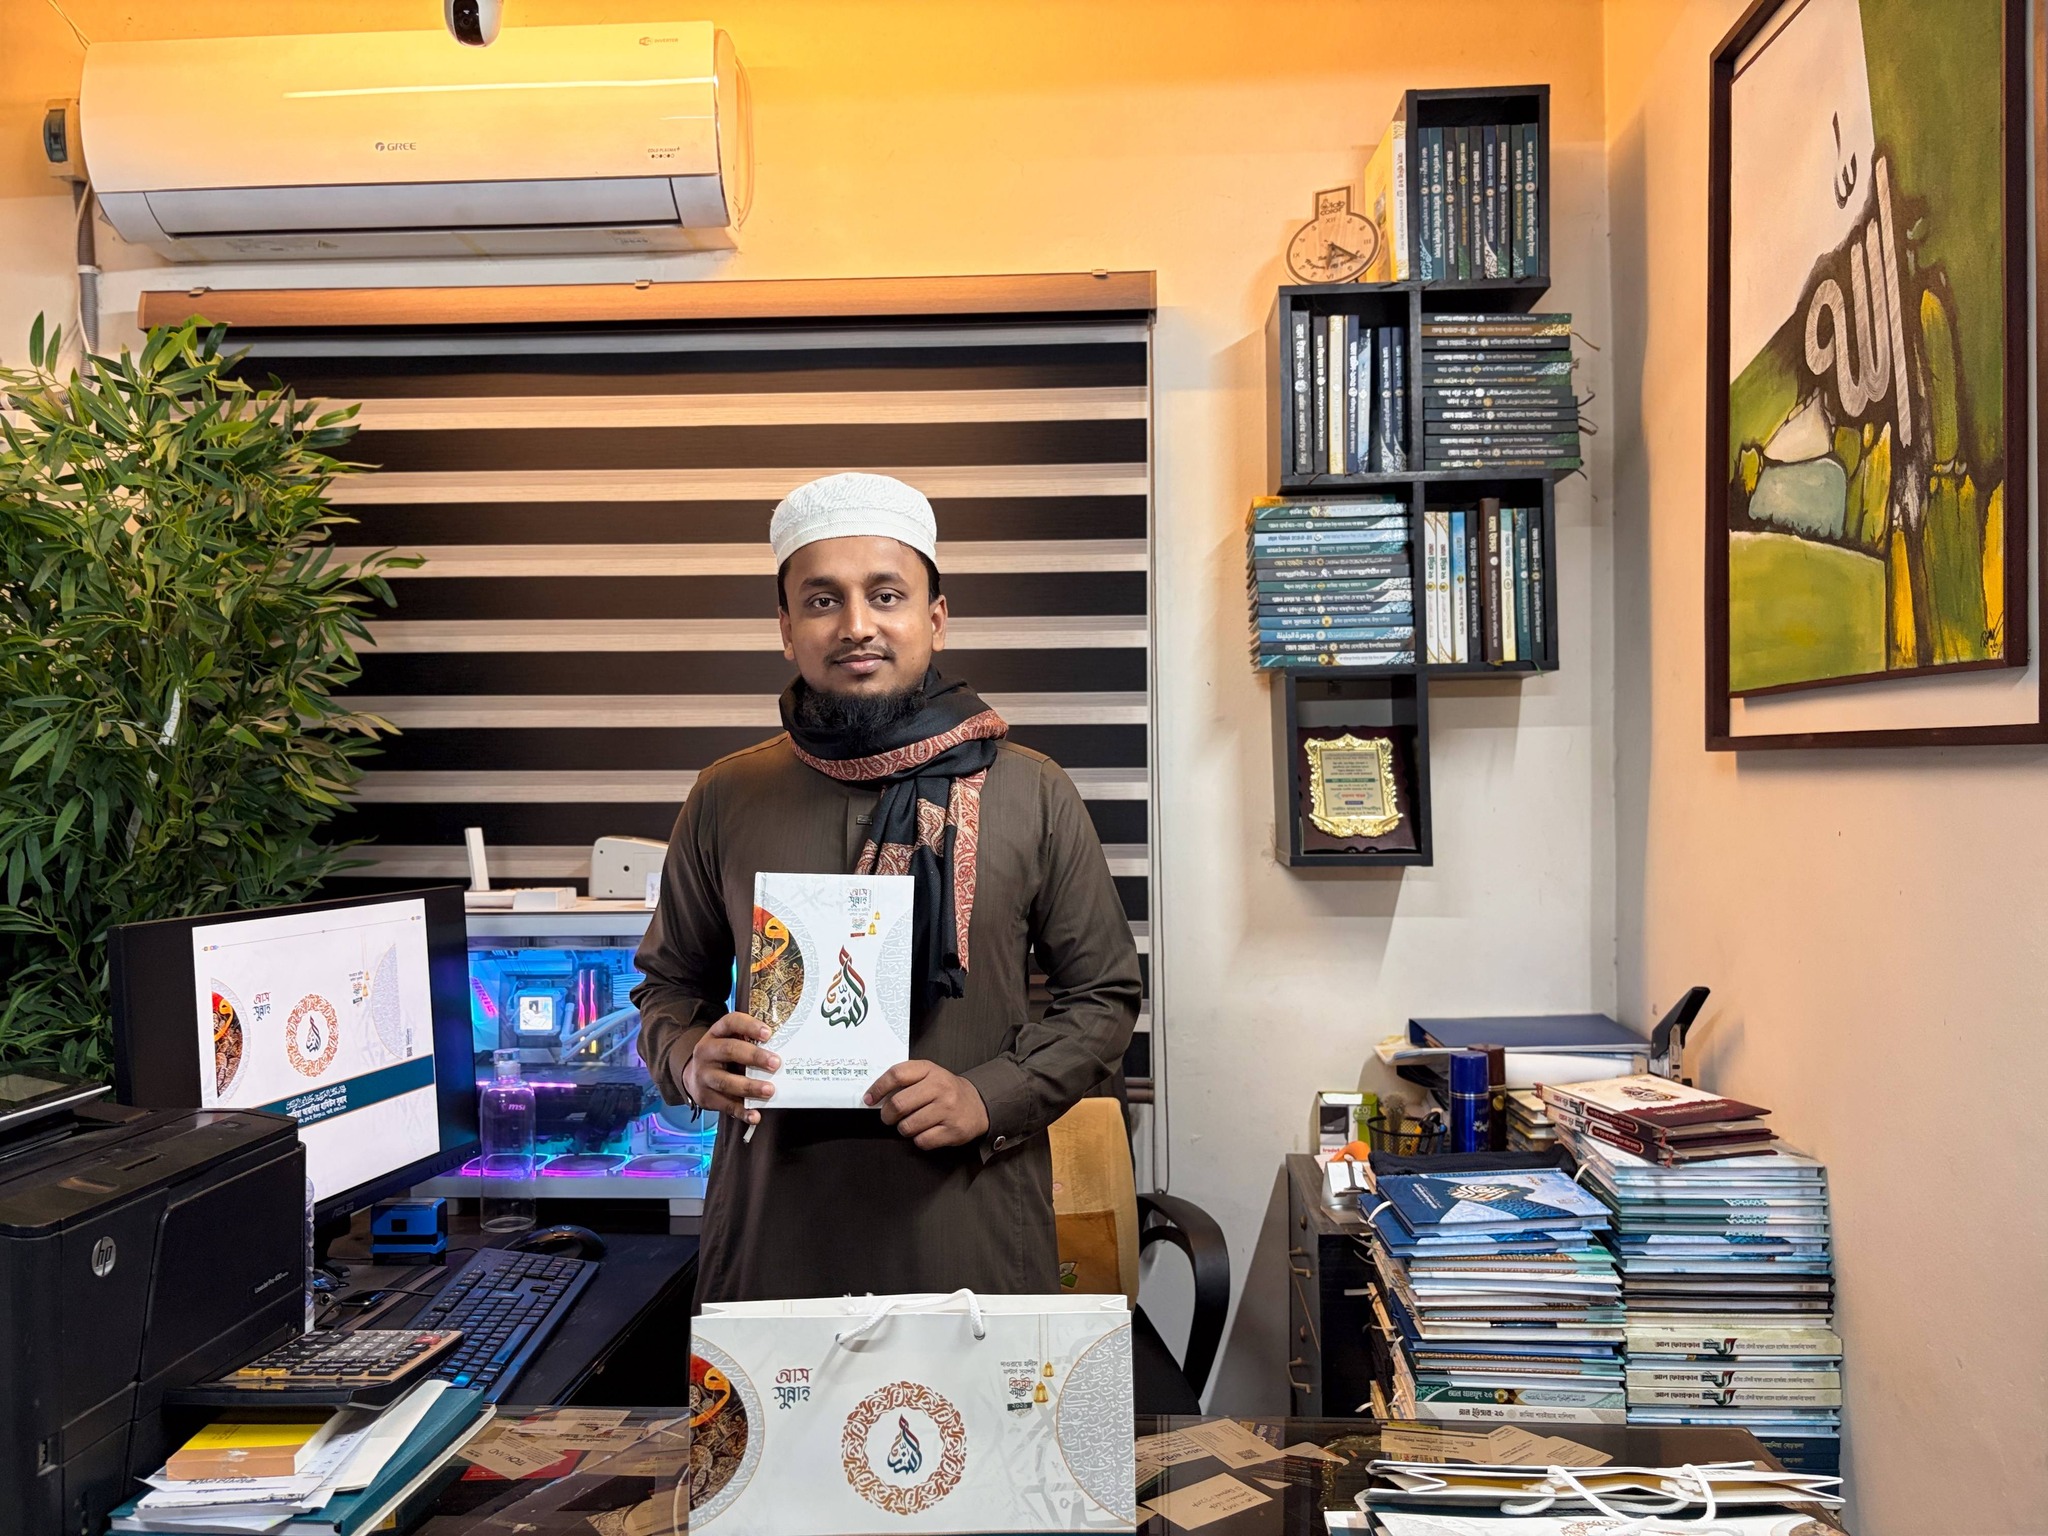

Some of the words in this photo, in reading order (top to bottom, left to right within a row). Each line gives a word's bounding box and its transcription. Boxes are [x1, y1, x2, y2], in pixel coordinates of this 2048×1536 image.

[387, 142, 417, 151] GREE
[785, 1066, 805, 1076] জামিয়া
[806, 1066, 830, 1076] আরাবিয়া
[508, 1103, 526, 1111] msi
[95, 1238, 114, 1277] hp
[775, 1368, 814, 1384] আস
[771, 1386, 811, 1410] সুন্নাহ
